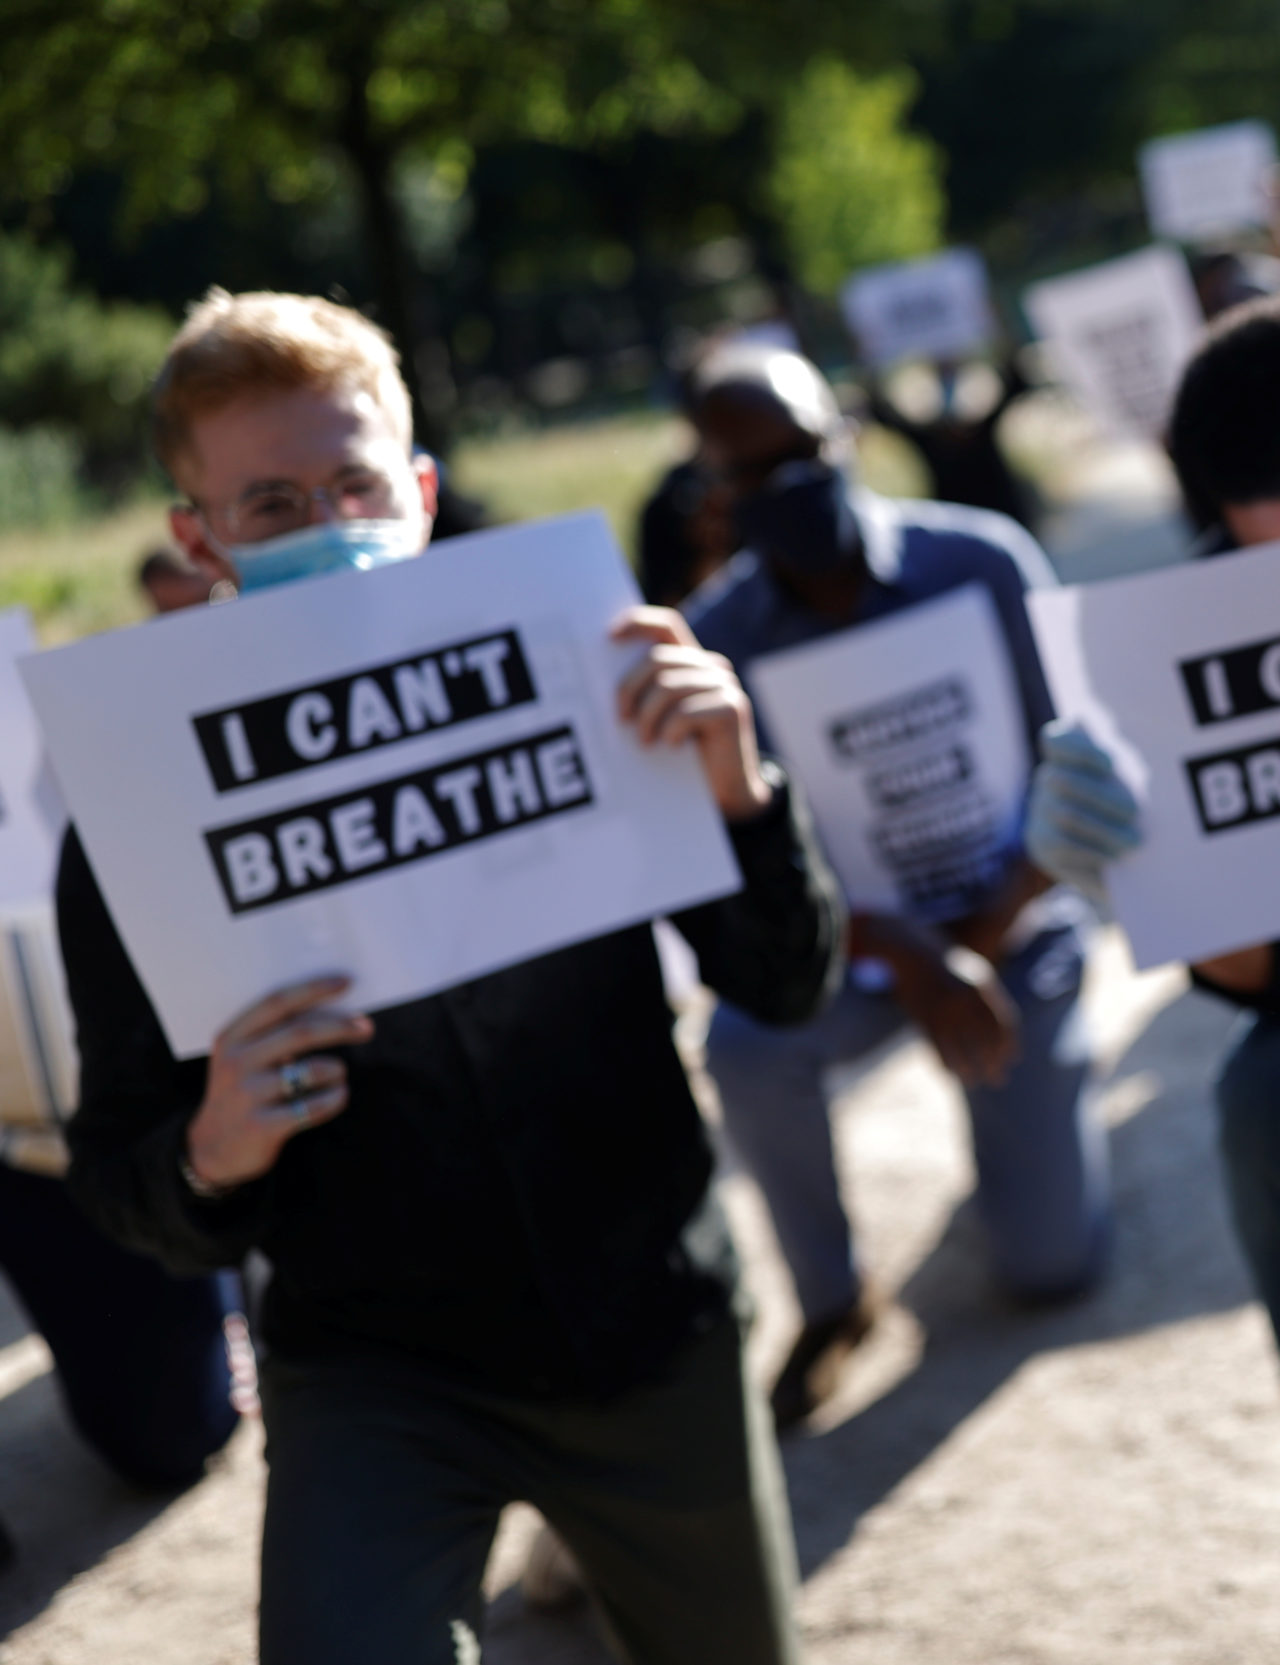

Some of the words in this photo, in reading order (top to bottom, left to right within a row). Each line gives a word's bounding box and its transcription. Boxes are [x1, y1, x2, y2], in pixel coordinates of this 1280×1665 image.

[221, 714, 256, 782] I
[286, 636, 512, 761] CAN'T
[1203, 660, 1234, 718] I
[223, 738, 587, 904] BREATHE
